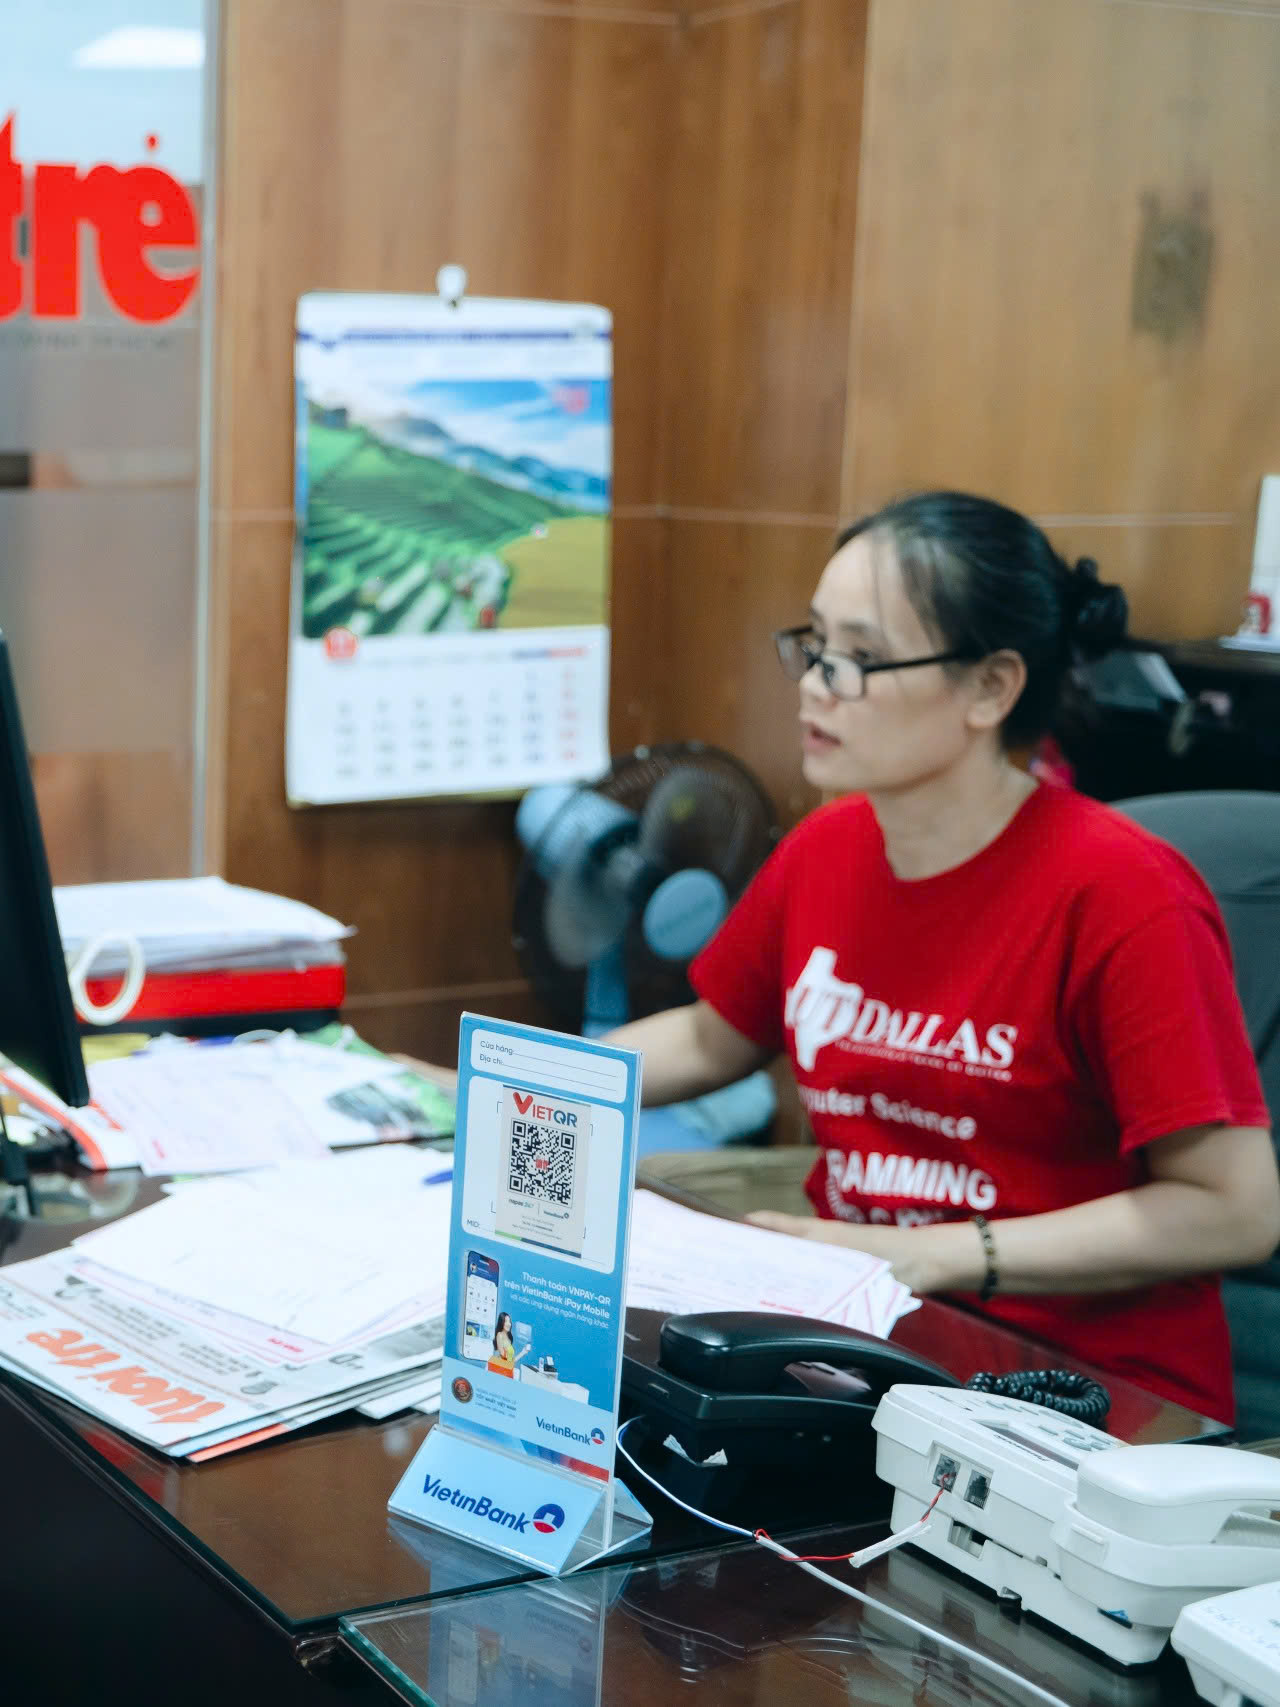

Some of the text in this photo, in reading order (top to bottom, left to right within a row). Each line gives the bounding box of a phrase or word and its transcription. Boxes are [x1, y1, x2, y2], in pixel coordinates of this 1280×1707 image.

[870, 1092, 977, 1141] Science
[521, 1284, 563, 1305] VietinBank
[564, 1297, 582, 1311] iPay
[582, 1303, 610, 1319] Mobile
[522, 1271, 547, 1286] Thanh
[568, 1285, 611, 1306] VNPAY-QR
[535, 1416, 591, 1446] VietinBank
[422, 1473, 532, 1535] VietinBank
